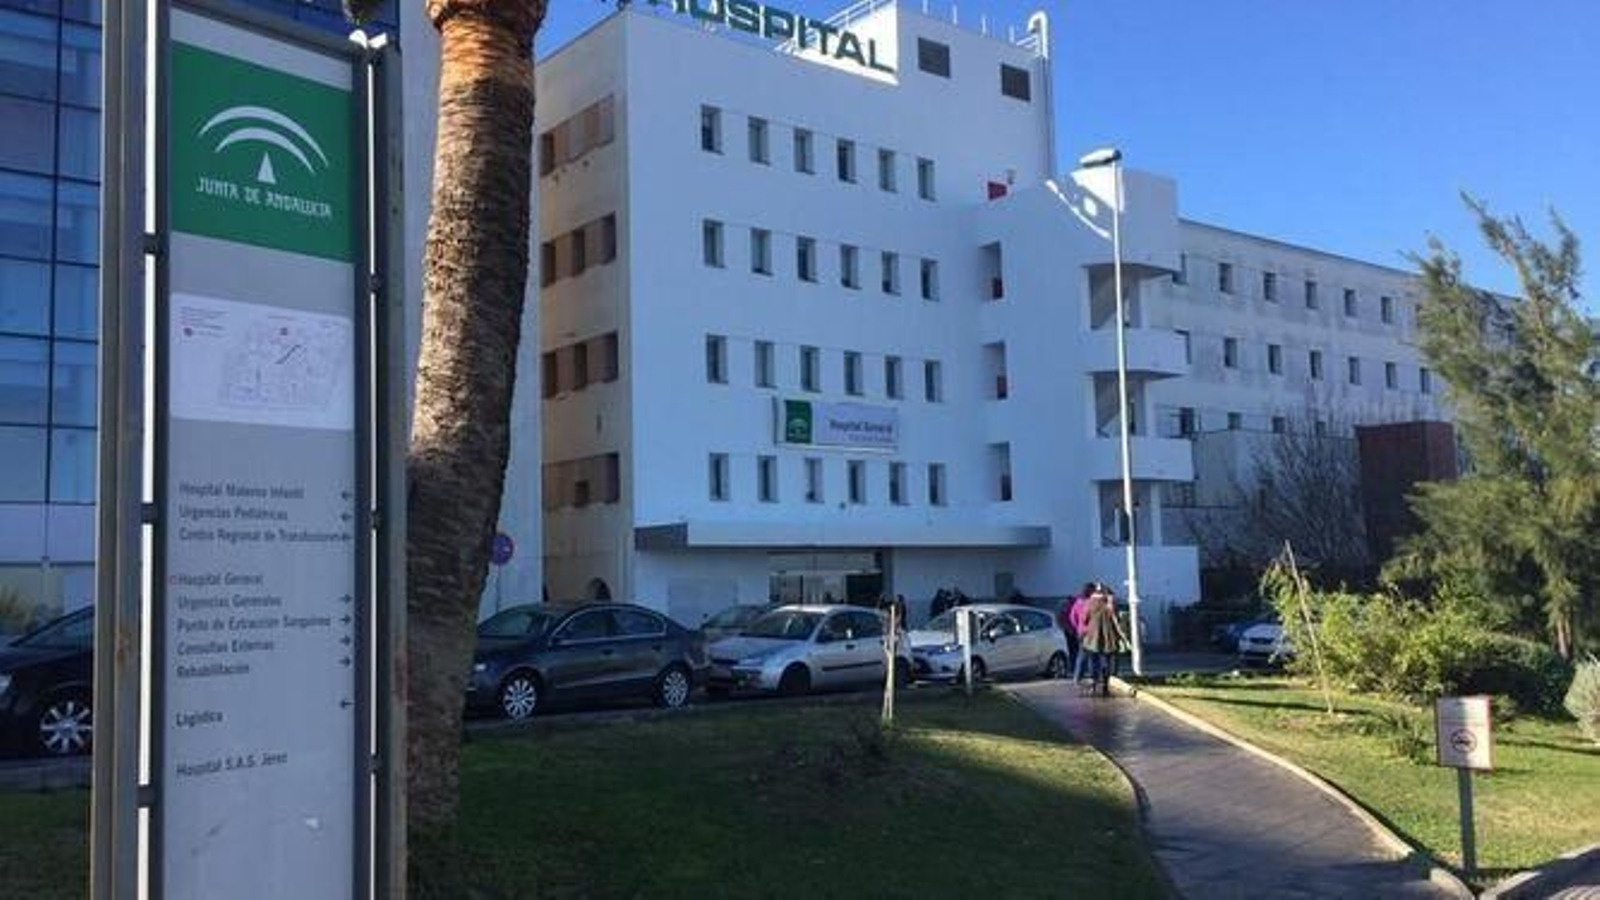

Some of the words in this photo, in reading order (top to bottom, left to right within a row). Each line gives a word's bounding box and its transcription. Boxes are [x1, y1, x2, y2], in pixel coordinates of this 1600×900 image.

[648, 0, 896, 74] OSPITAL
[195, 177, 239, 199] JUNTA
[243, 186, 261, 205] DE
[179, 482, 222, 497] Hospital
[226, 484, 267, 499] Materno
[270, 485, 304, 499] Infantil
[179, 504, 230, 521] Urgencias
[179, 527, 214, 540] Centro
[217, 528, 260, 543] Regional
[264, 529, 275, 540] de
[178, 573, 220, 589] Hospital
[224, 573, 263, 586] General
[178, 596, 229, 610] Urgencias
[232, 594, 282, 608] Generales
[177, 618, 208, 632] Punto
[212, 617, 224, 630] de
[177, 641, 228, 655] Consultas
[231, 639, 274, 652] Externas
[176, 760, 221, 776] Hospital
